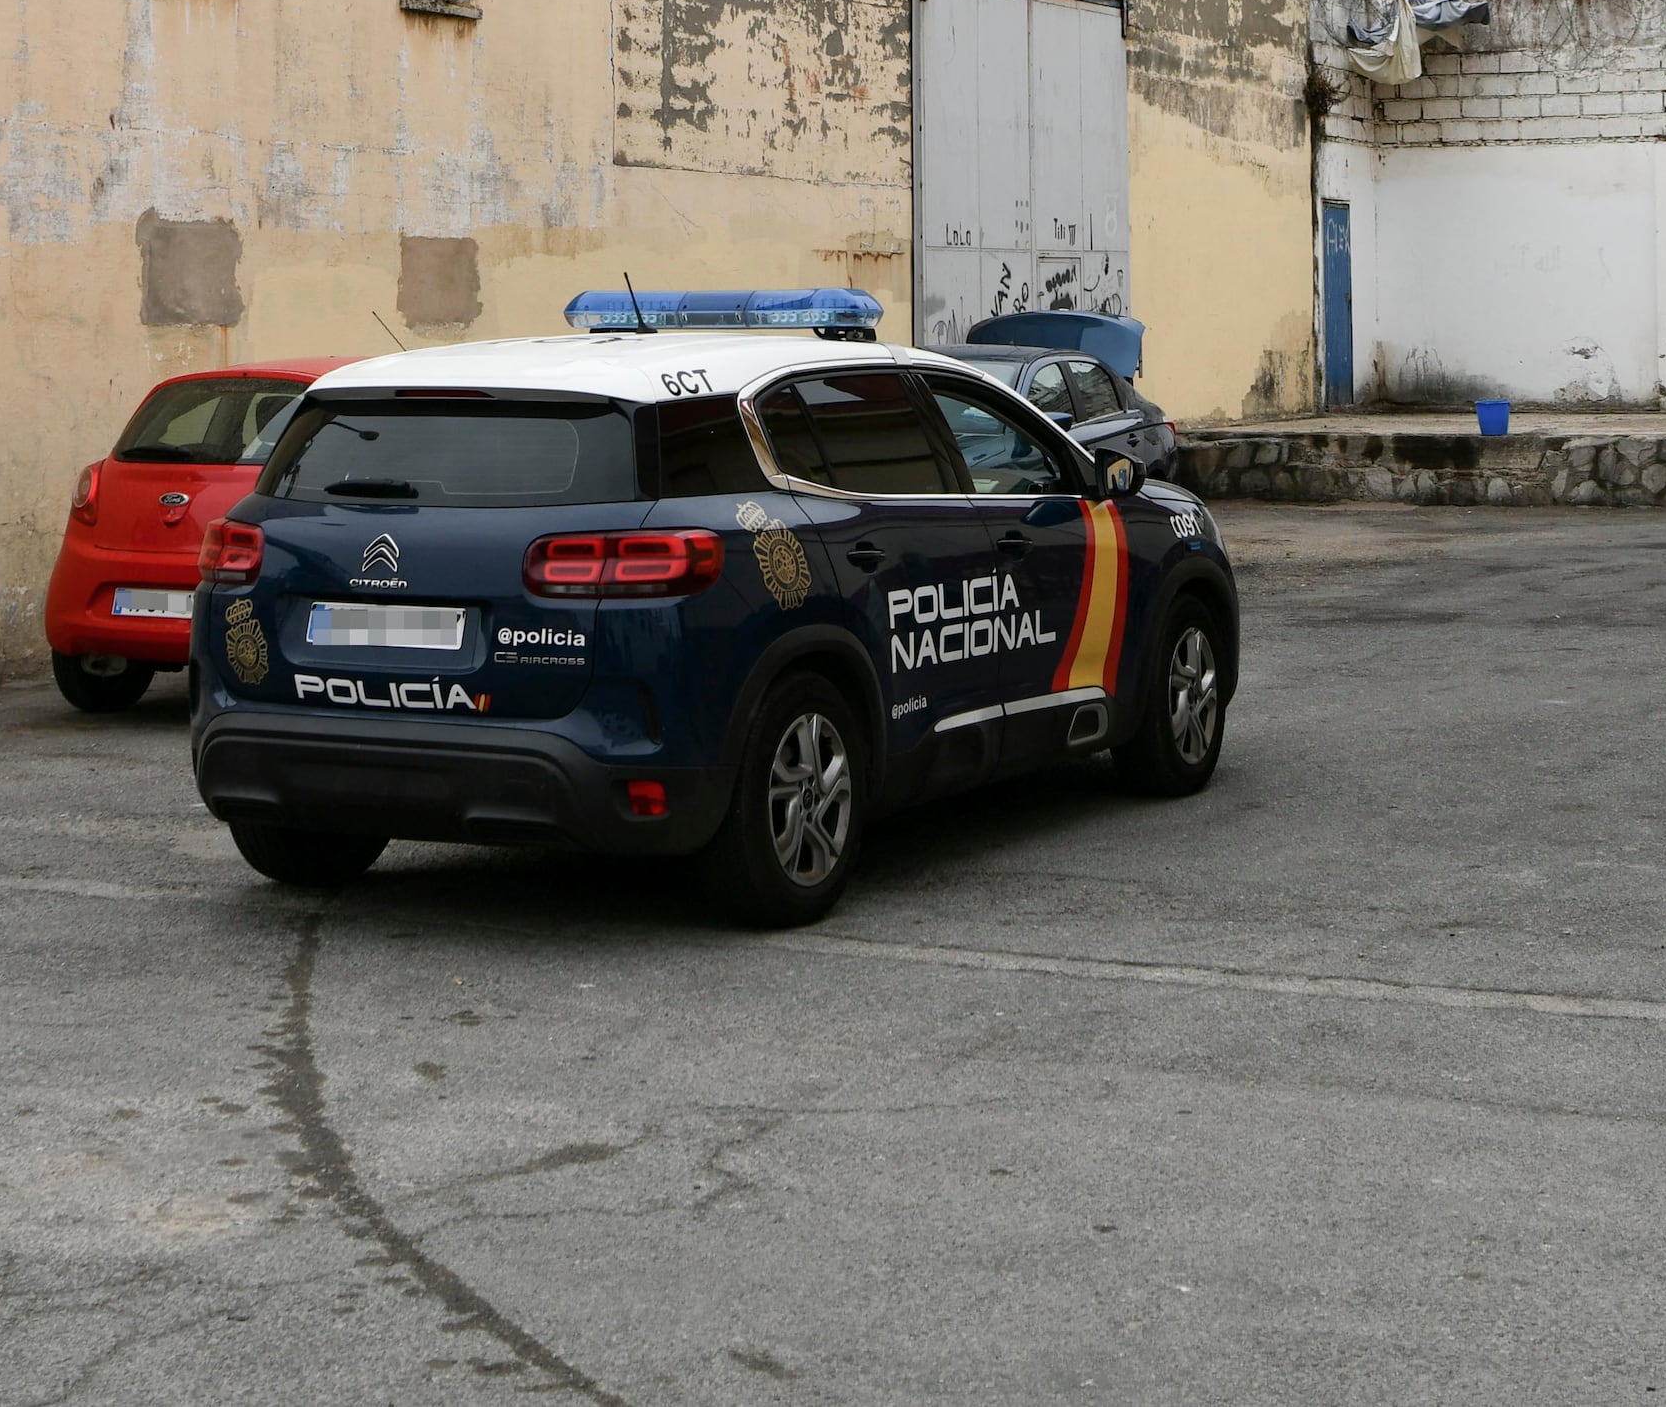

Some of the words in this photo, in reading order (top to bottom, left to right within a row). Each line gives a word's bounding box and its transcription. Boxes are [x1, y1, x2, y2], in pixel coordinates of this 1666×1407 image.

[660, 369, 714, 397] 6CT
[888, 567, 1021, 630] POLICÍA
[497, 627, 586, 647] @policia
[891, 609, 1057, 674] NACIONAL
[520, 656, 586, 666] AIRCROSS
[294, 675, 477, 711] POLICÍA
[891, 695, 928, 720] @policia
